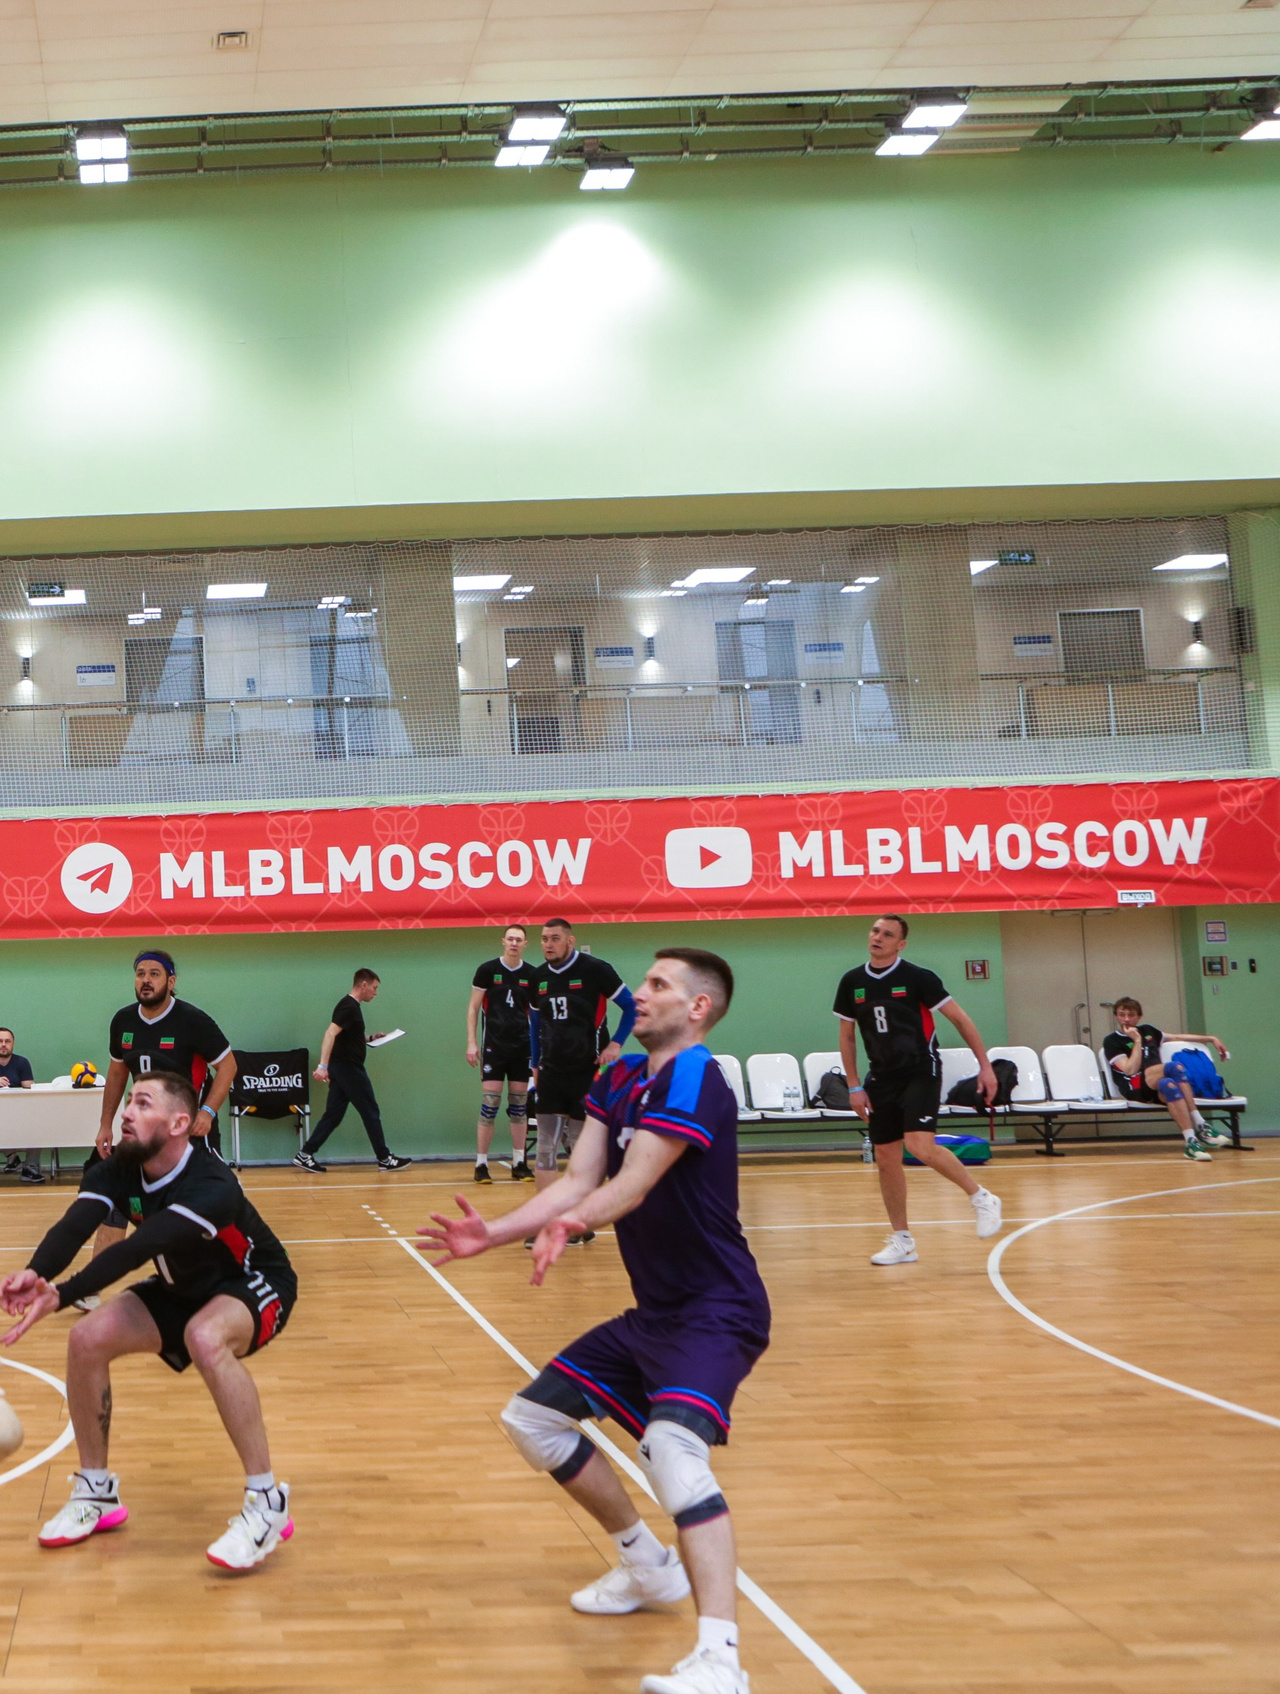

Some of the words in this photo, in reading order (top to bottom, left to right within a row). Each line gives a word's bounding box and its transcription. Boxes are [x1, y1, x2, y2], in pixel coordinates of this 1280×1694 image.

[778, 817, 1208, 879] MLBLMOSCOW
[159, 837, 592, 899] MLBLMOSCOW
[505, 989, 515, 1008] 4
[549, 996, 569, 1020] 13
[873, 1006, 888, 1033] 8
[242, 1073, 303, 1090] SPALDING
